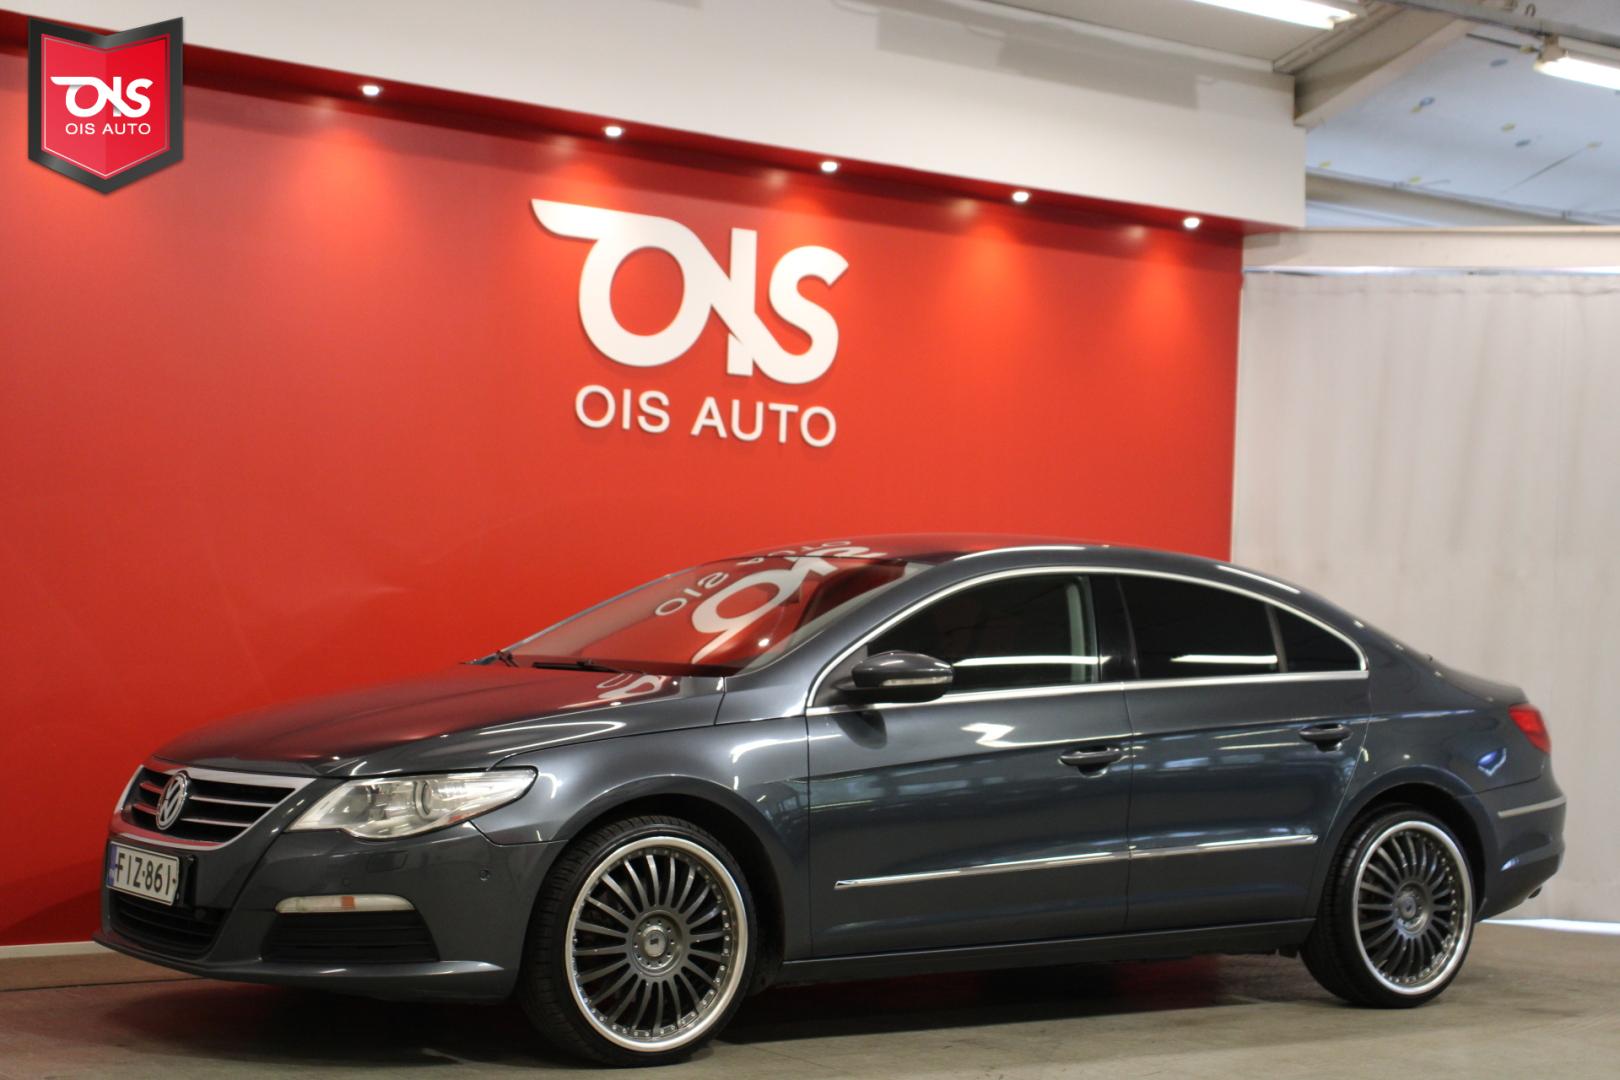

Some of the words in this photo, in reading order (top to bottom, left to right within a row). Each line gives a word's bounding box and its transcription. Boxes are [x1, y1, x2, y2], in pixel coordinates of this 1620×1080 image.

[575, 385, 671, 433] OIS
[690, 396, 837, 447] AUTO
[117, 853, 171, 895] FIZ-861
